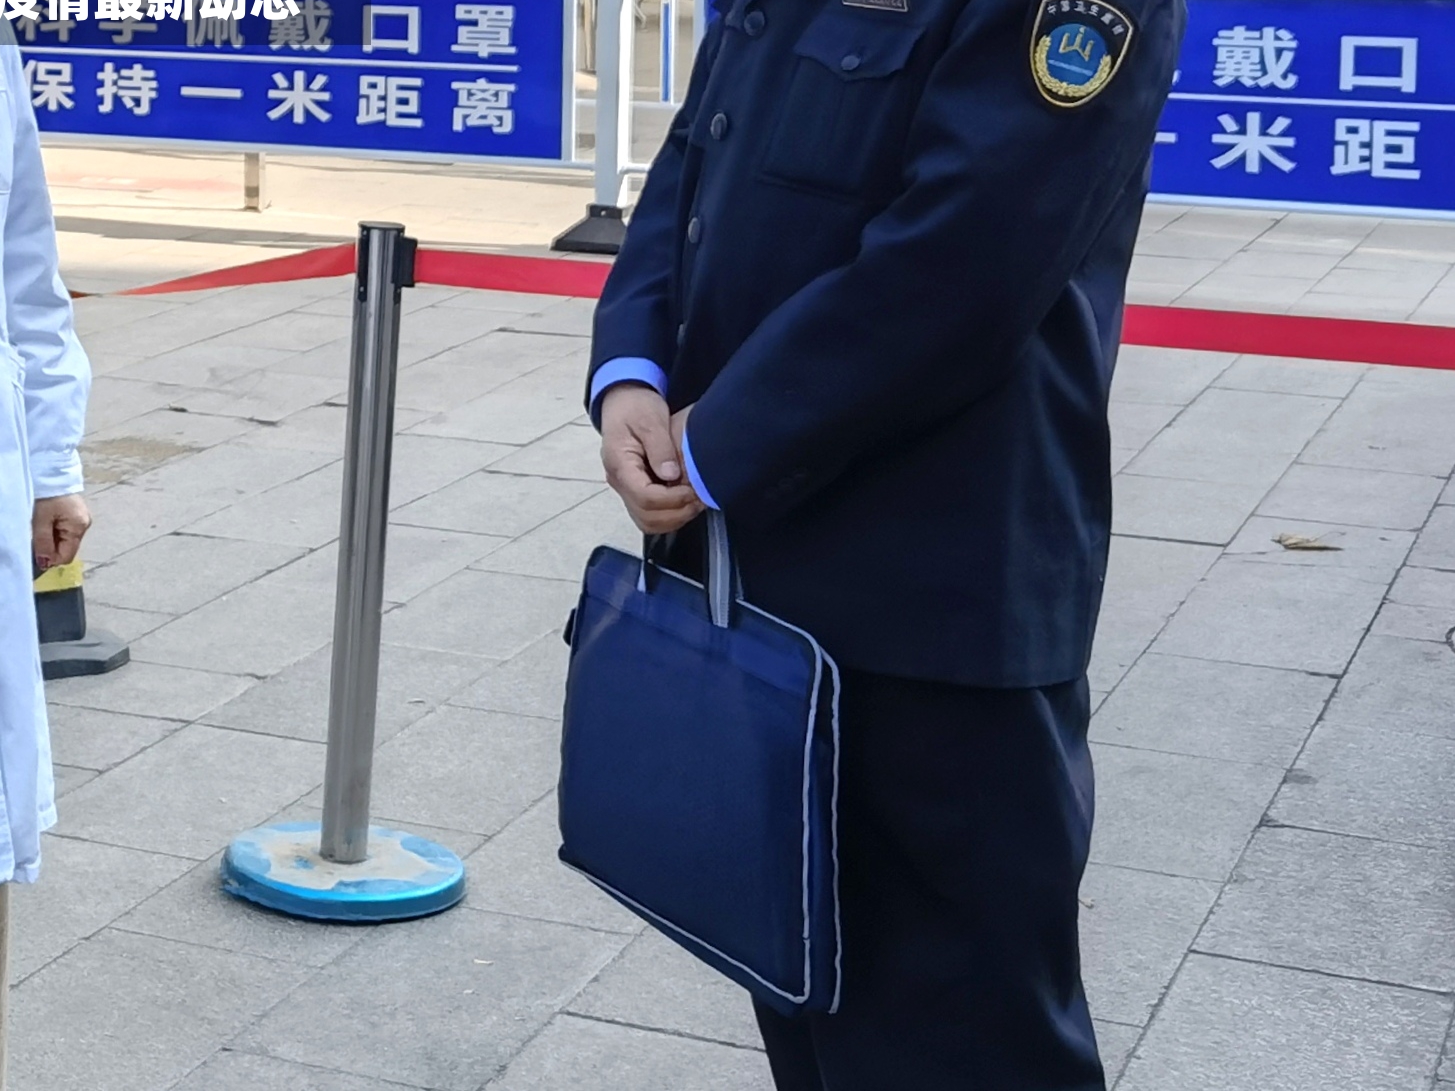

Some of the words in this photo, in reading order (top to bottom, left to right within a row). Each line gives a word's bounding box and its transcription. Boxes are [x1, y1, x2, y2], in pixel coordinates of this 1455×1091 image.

[1172, 24, 1420, 93] 戴口
[23, 59, 518, 134] 保持一米距离
